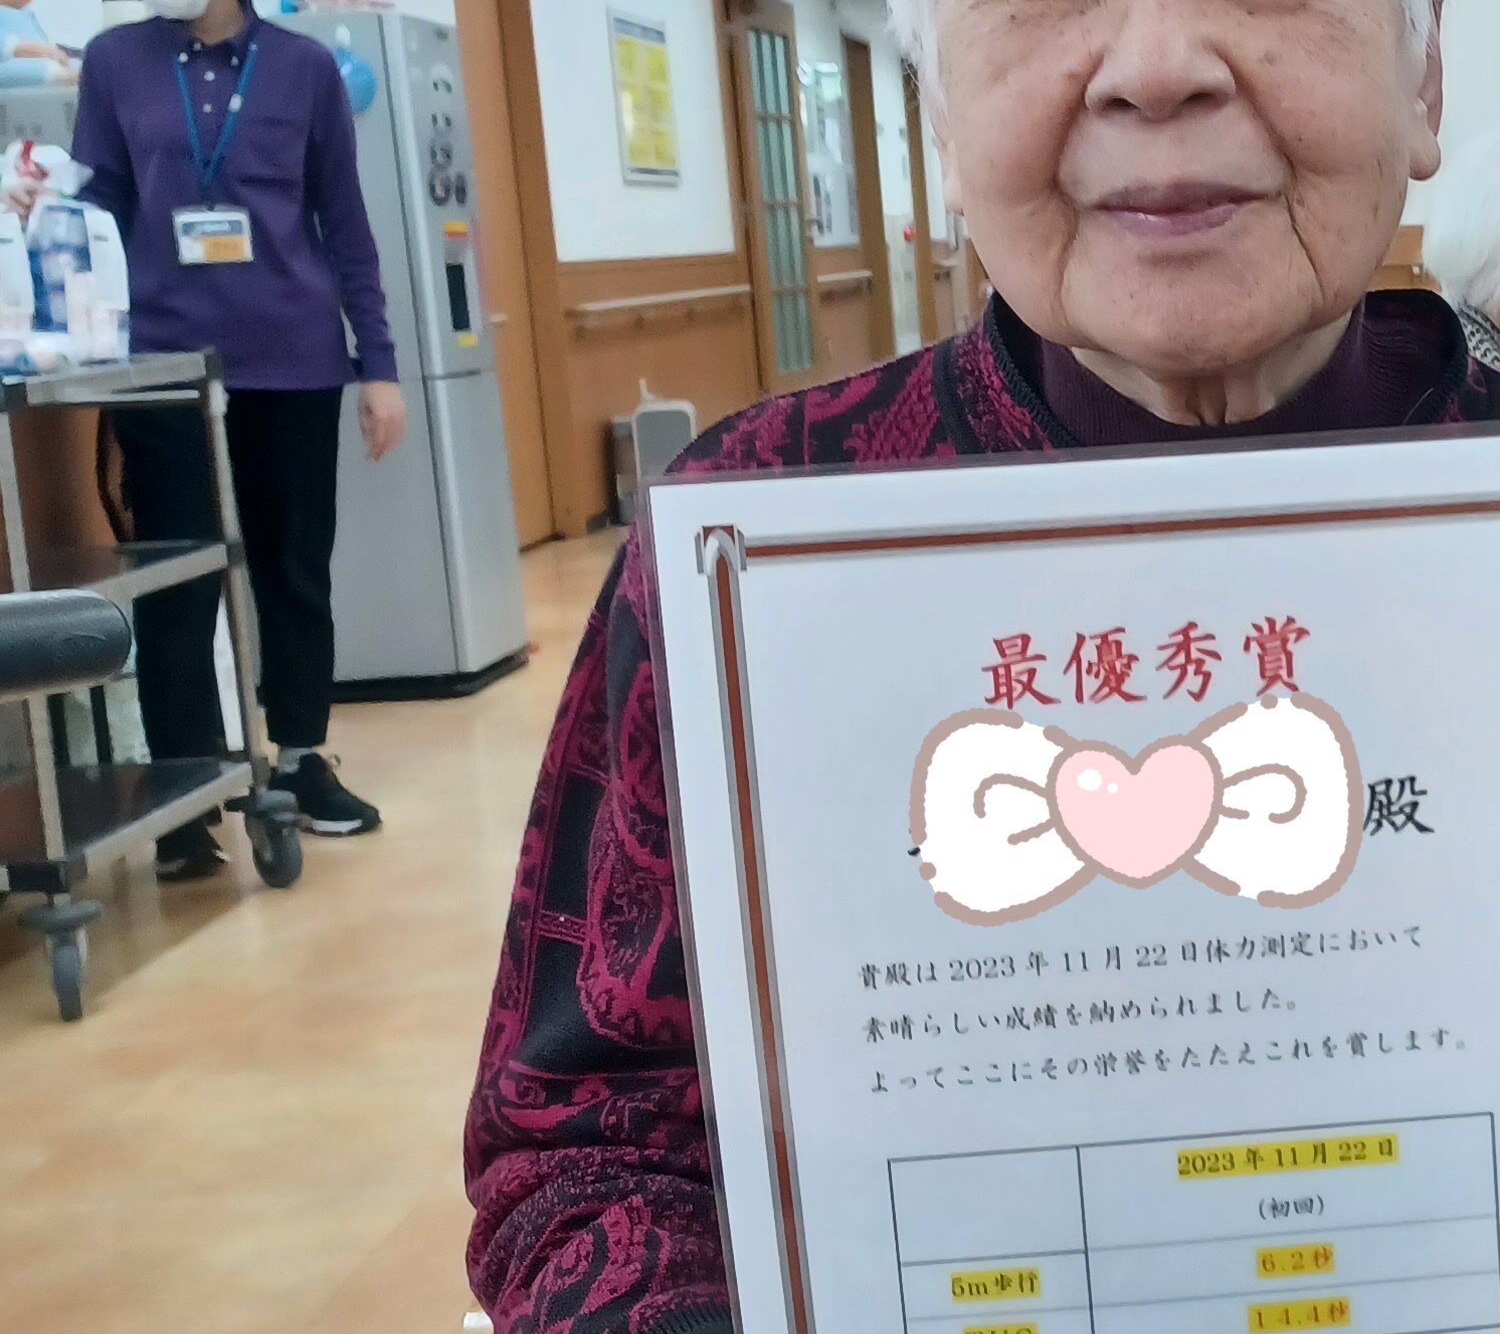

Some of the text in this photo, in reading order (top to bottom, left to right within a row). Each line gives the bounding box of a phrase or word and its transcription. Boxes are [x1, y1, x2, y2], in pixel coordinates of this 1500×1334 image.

[981, 615, 1311, 710] 最優秀賞
[1362, 774, 1435, 836] 殿
